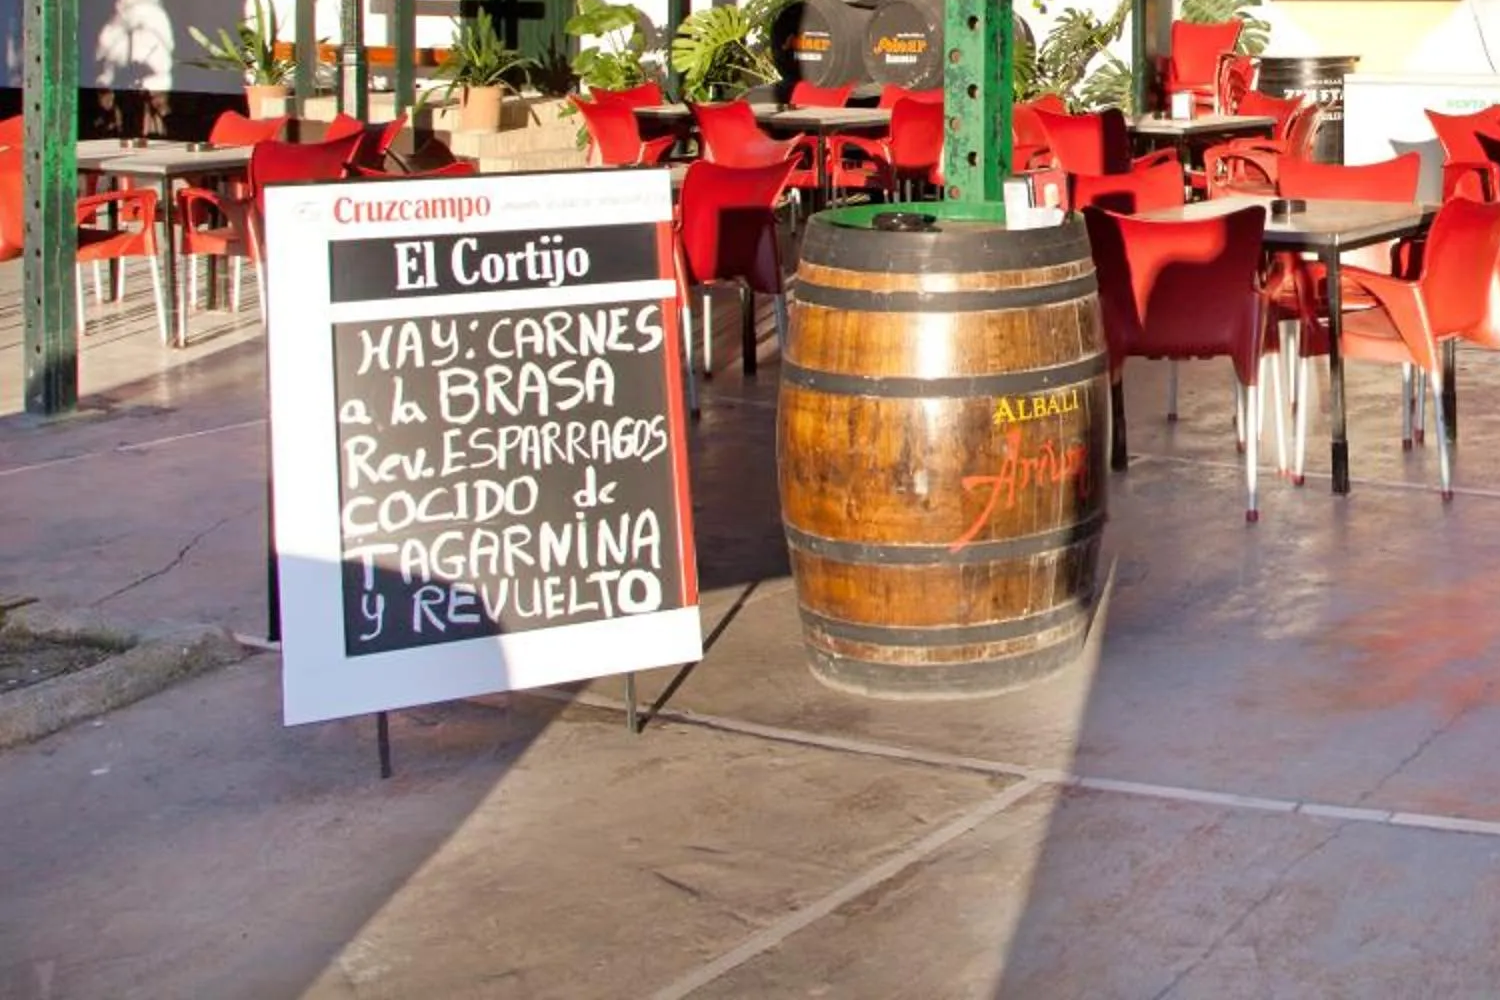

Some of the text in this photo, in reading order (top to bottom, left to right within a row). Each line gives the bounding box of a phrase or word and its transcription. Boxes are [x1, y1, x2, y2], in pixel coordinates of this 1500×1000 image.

[333, 195, 491, 224] Cruzcampo
[395, 235, 590, 290] El Cortijo
[487, 304, 664, 359] CARNES
[339, 357, 615, 425] a la BRASA
[992, 390, 1080, 425] ALBALI
[440, 415, 668, 477] ESPARRAGOS
[342, 465, 618, 535] COCIDO de
[412, 569, 663, 633] REVUELTO
